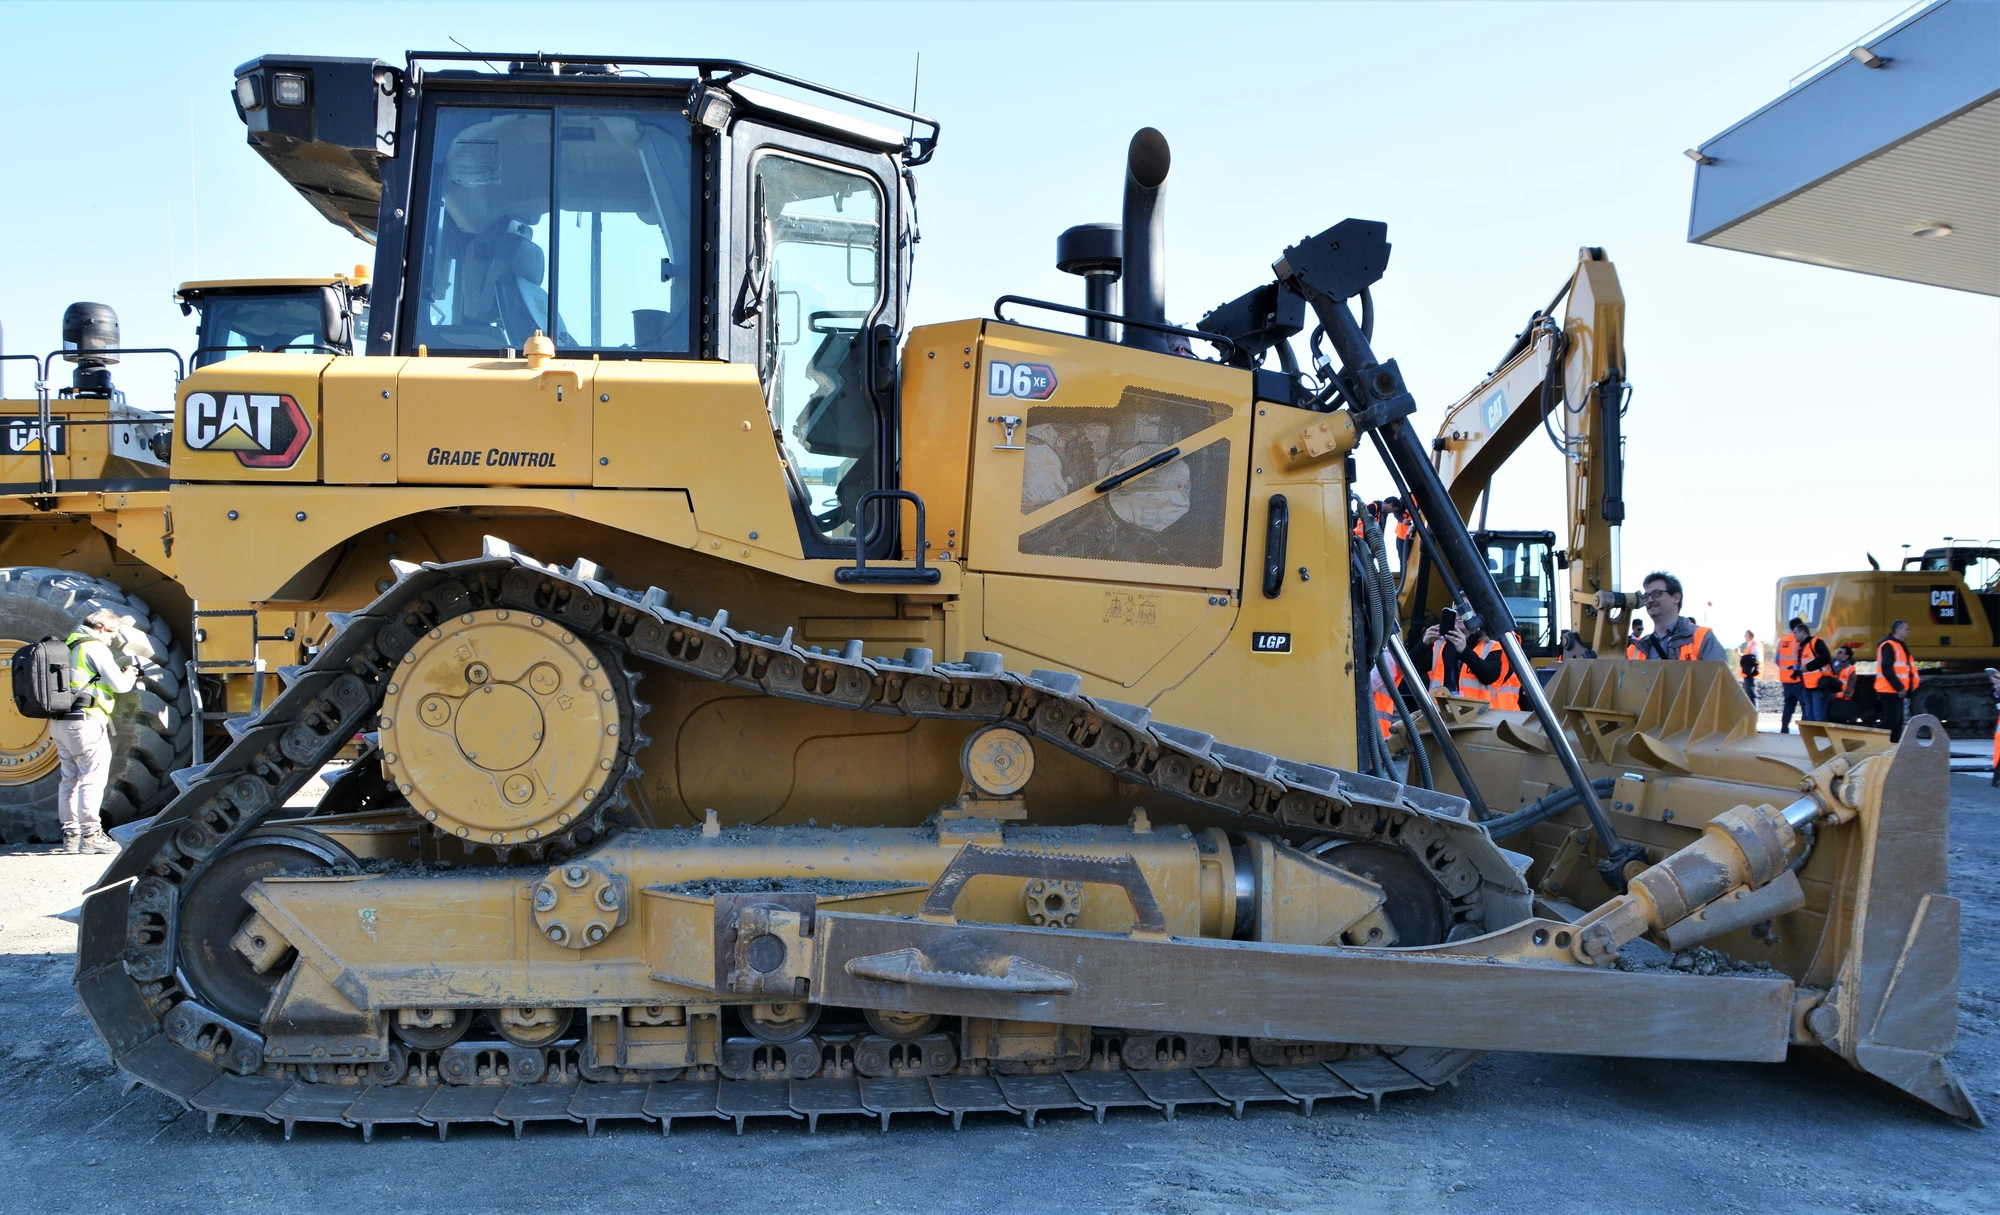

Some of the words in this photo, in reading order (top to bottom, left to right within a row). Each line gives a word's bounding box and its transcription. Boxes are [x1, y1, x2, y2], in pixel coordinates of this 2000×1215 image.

[991, 363, 1032, 397] D6
[1033, 376, 1046, 388] XE
[185, 392, 280, 450] CAT
[1488, 394, 1503, 429] CAT
[427, 447, 482, 466] GRADE
[486, 448, 557, 468] CONTROL
[1789, 592, 1818, 623] CAT
[1931, 590, 1955, 606] CAT
[1940, 608, 1955, 617] 336
[1258, 635, 1286, 649] LGP
